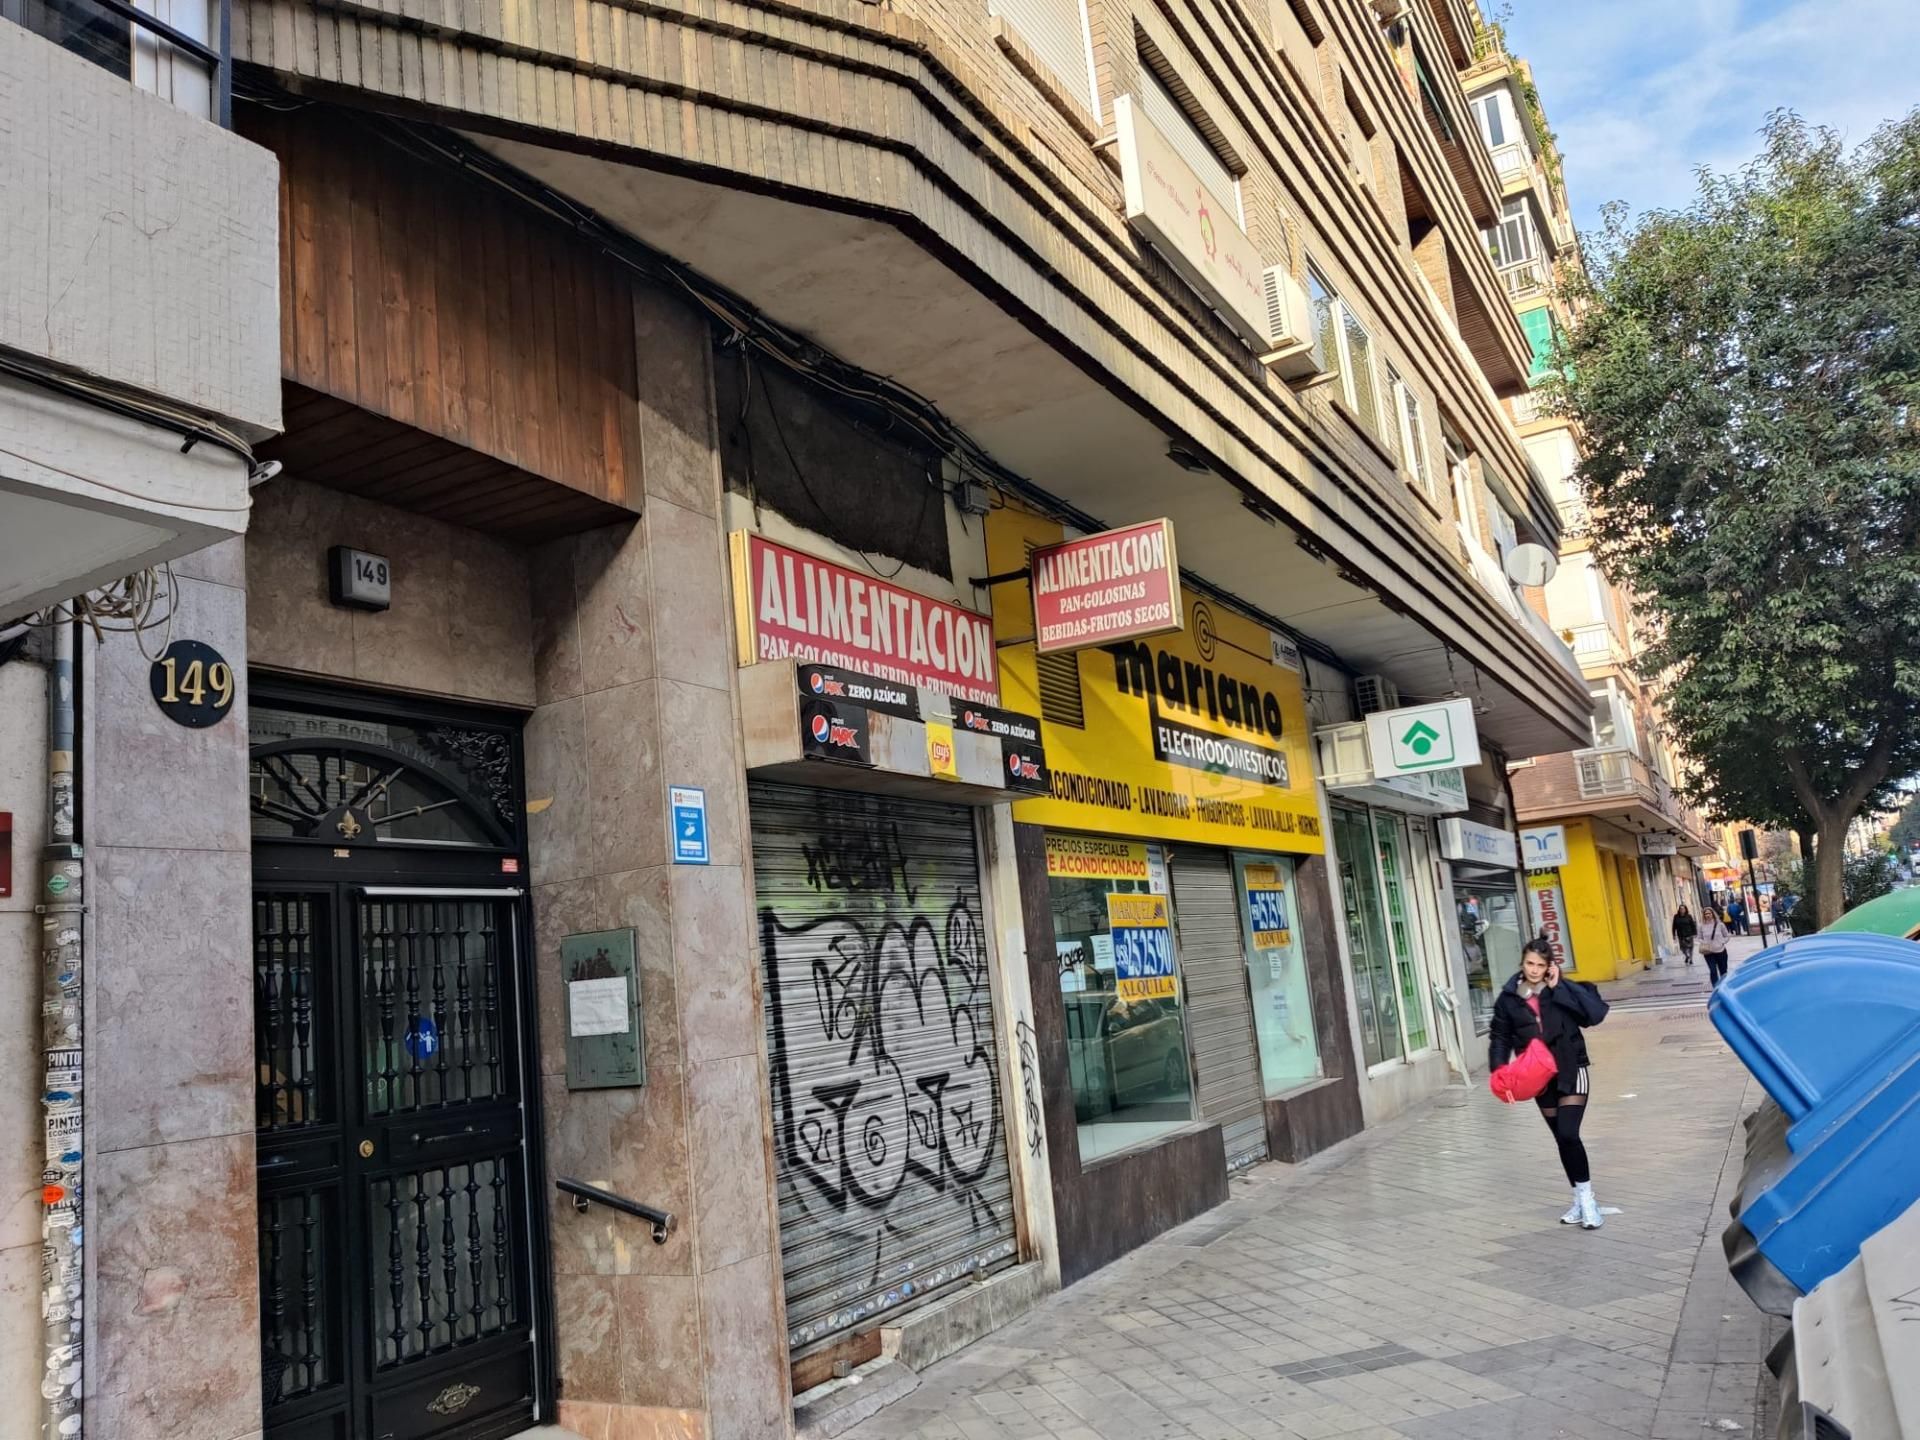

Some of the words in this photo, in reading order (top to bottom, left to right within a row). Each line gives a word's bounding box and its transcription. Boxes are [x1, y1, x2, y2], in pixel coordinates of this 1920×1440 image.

[356, 559, 388, 586] 149
[1038, 530, 1166, 596] ALIMENTACION
[1059, 581, 1147, 614] PAN-GOLOSINAS
[759, 547, 994, 683] ALIMENTACION
[1042, 610, 1132, 642] BEBIDAS-FRUTOS
[1134, 602, 1170, 624] SECOS
[161, 657, 234, 709] 149
[848, 684, 872, 701] ZERO
[872, 686, 908, 706] AZÚCAR
[1111, 640, 1284, 743] mariano
[830, 725, 861, 749] MAX
[991, 721, 1010, 735] ZERO
[1010, 723, 1037, 741] AZÚCAR
[932, 742, 951, 760] Lay's
[1158, 726, 1288, 782] ELECTRODOMESTICOS
[1140, 785, 1191, 820] LAVADORAS
[1046, 837, 1082, 854] PRECIOS
[1084, 841, 1130, 857] ESPECIALES
[1060, 855, 1146, 876] ACONDICIONADO
[1123, 928, 1172, 977] 252590
[1122, 979, 1175, 997] ALQUILA
